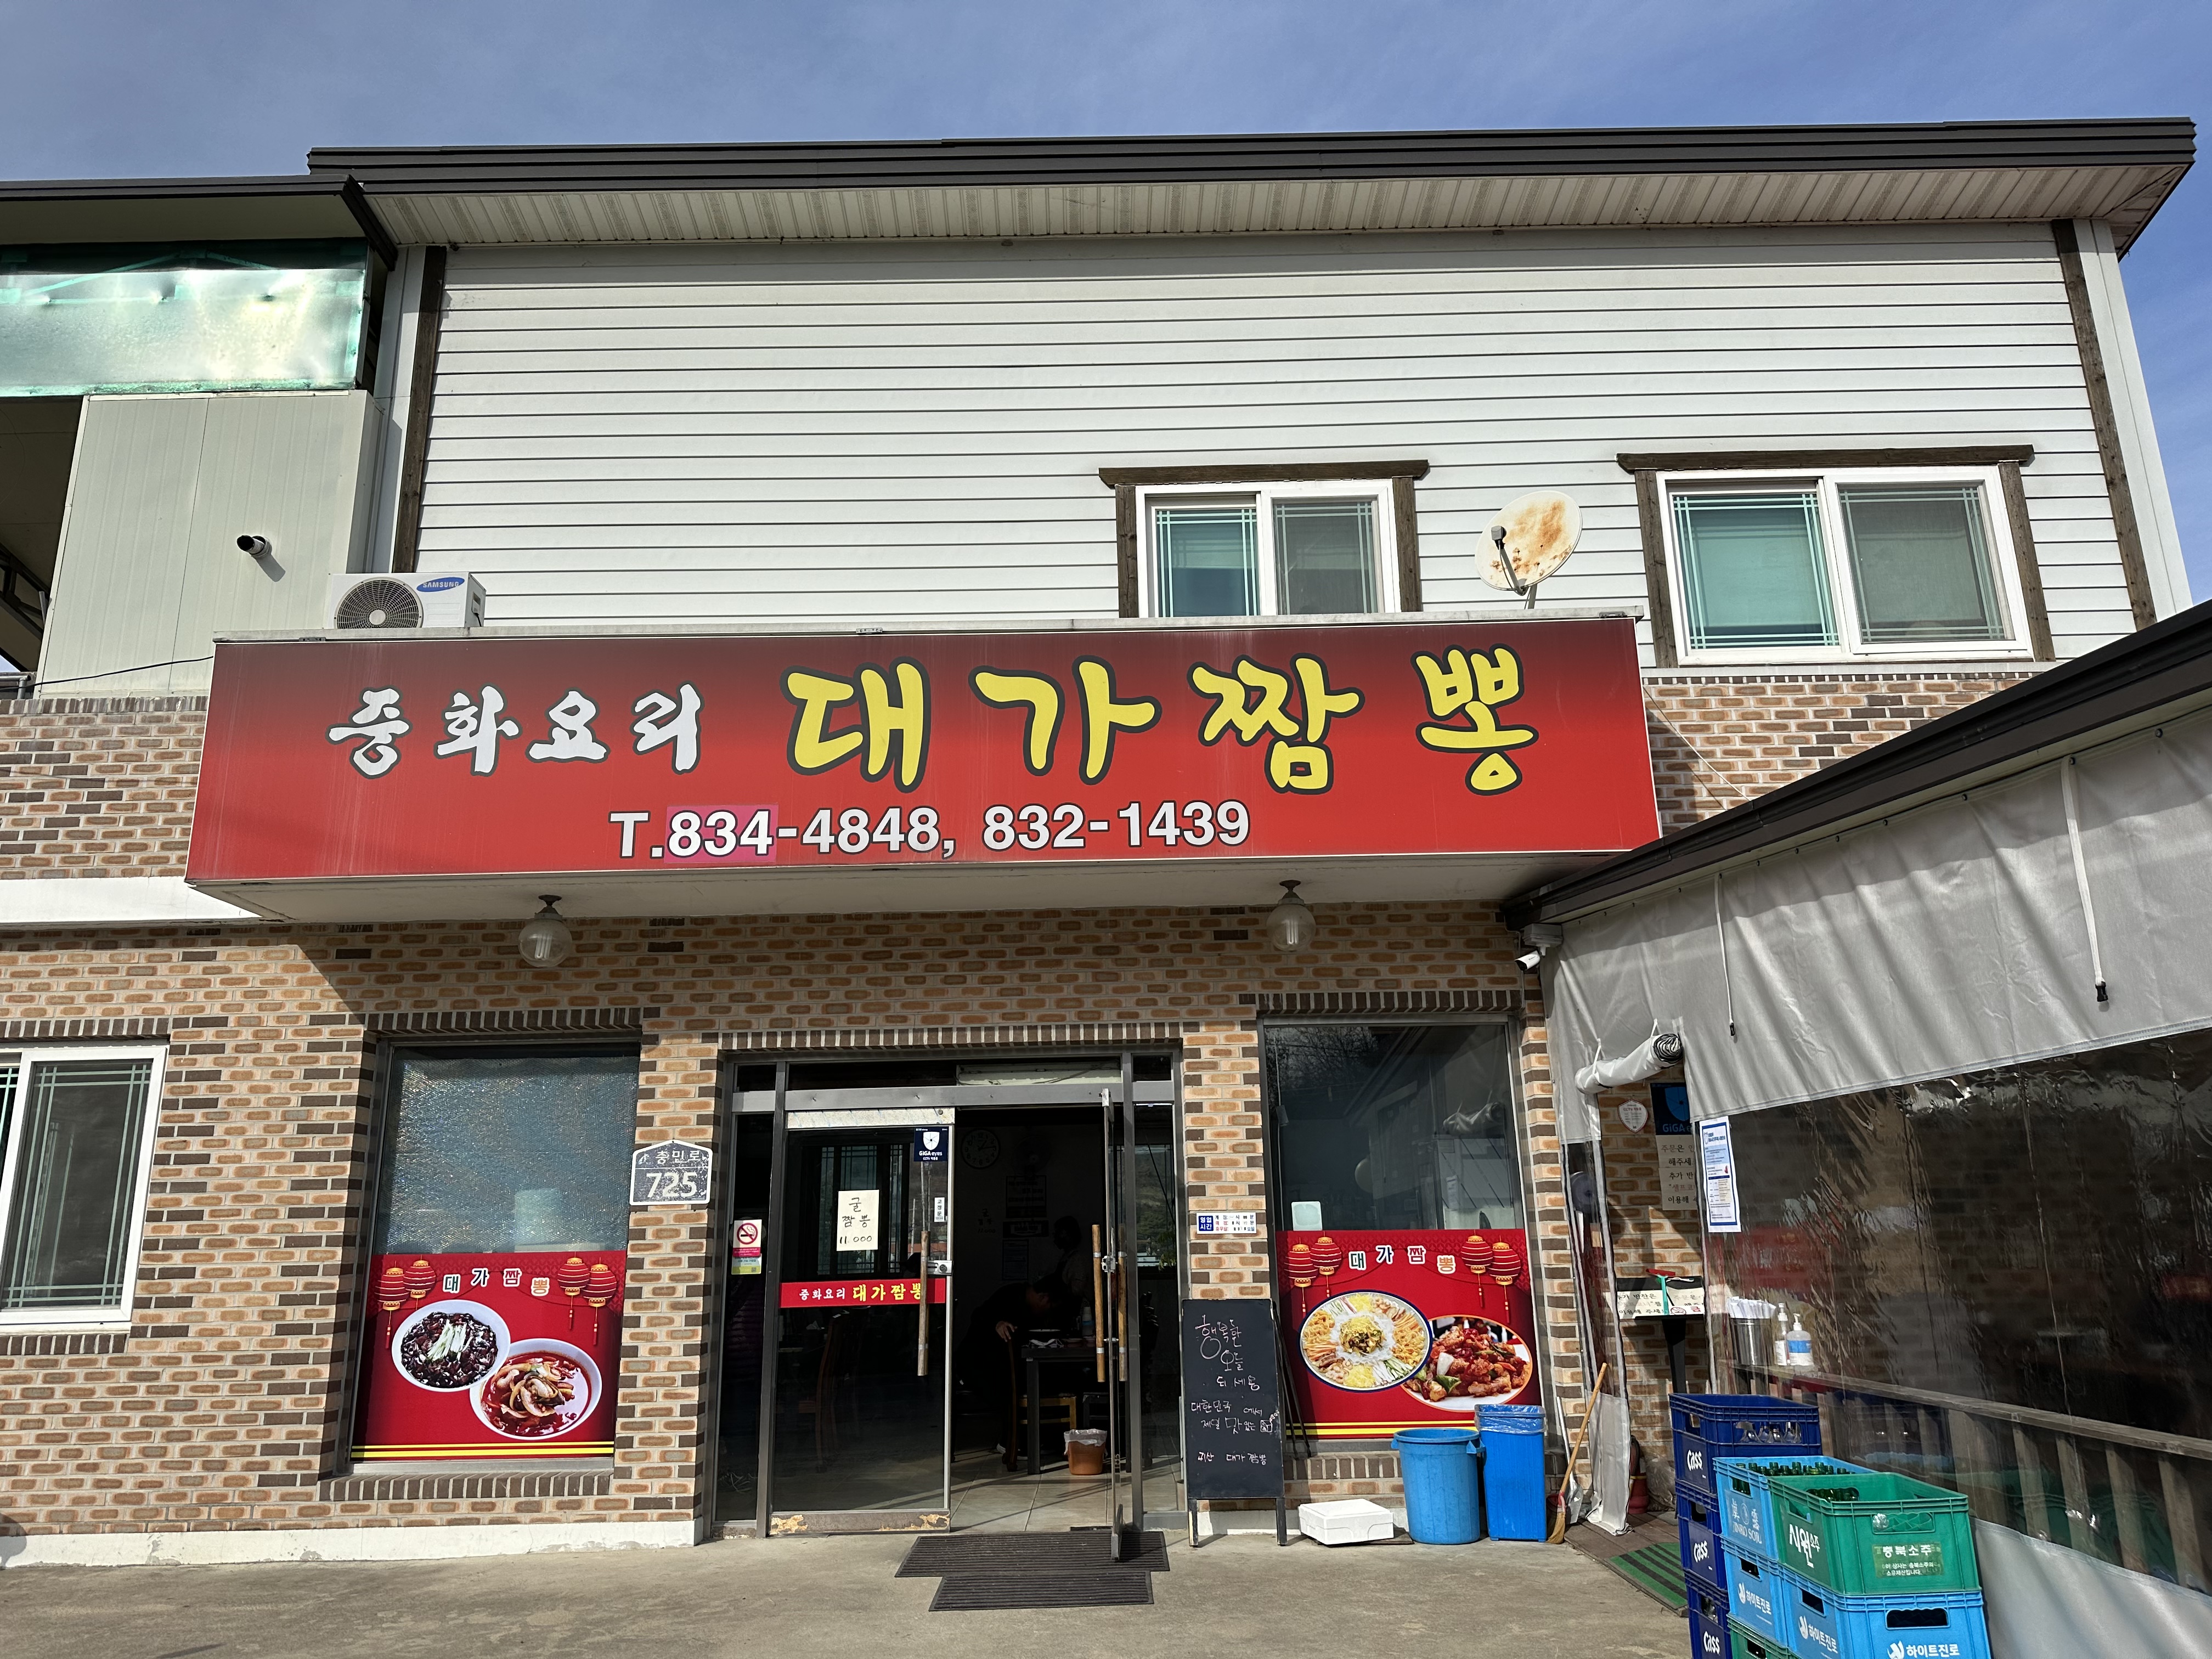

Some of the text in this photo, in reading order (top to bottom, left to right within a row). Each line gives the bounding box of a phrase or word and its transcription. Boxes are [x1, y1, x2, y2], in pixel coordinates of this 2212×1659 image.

[326, 644, 1538, 792] 중화요리 대가짬뽕
[983, 799, 1250, 852] 832-1439
[656, 1150, 701, 1165] 충민로
[1661, 1144, 1684, 1153] 주문은
[1668, 1158, 1692, 1166] 해주세
[646, 1172, 697, 1198] 725
[849, 1197, 861, 1212] 굴
[1348, 1245, 1457, 1274] 대가짬뽕
[442, 1267, 550, 1297] 대가짬뽕
[799, 1283, 921, 1301] 중화요리 대가짬뽕
[1220, 1350, 1244, 1372] 오늘
[1191, 1400, 1232, 1413] 대한민국
[1201, 1418, 1220, 1430] 제일
[1687, 1449, 1702, 1471] Cass
[1733, 1522, 1762, 1544] JINRO SOJU
[1694, 1541, 1708, 1562] Cass
[1882, 1544, 1932, 1558] 충북소주
[1746, 1590, 1771, 1615] 하이트진로
[1703, 1630, 1720, 1655] Cass
[1808, 1624, 1838, 1654] 하이트진로
[1906, 1644, 1960, 1658] 하이트진로
